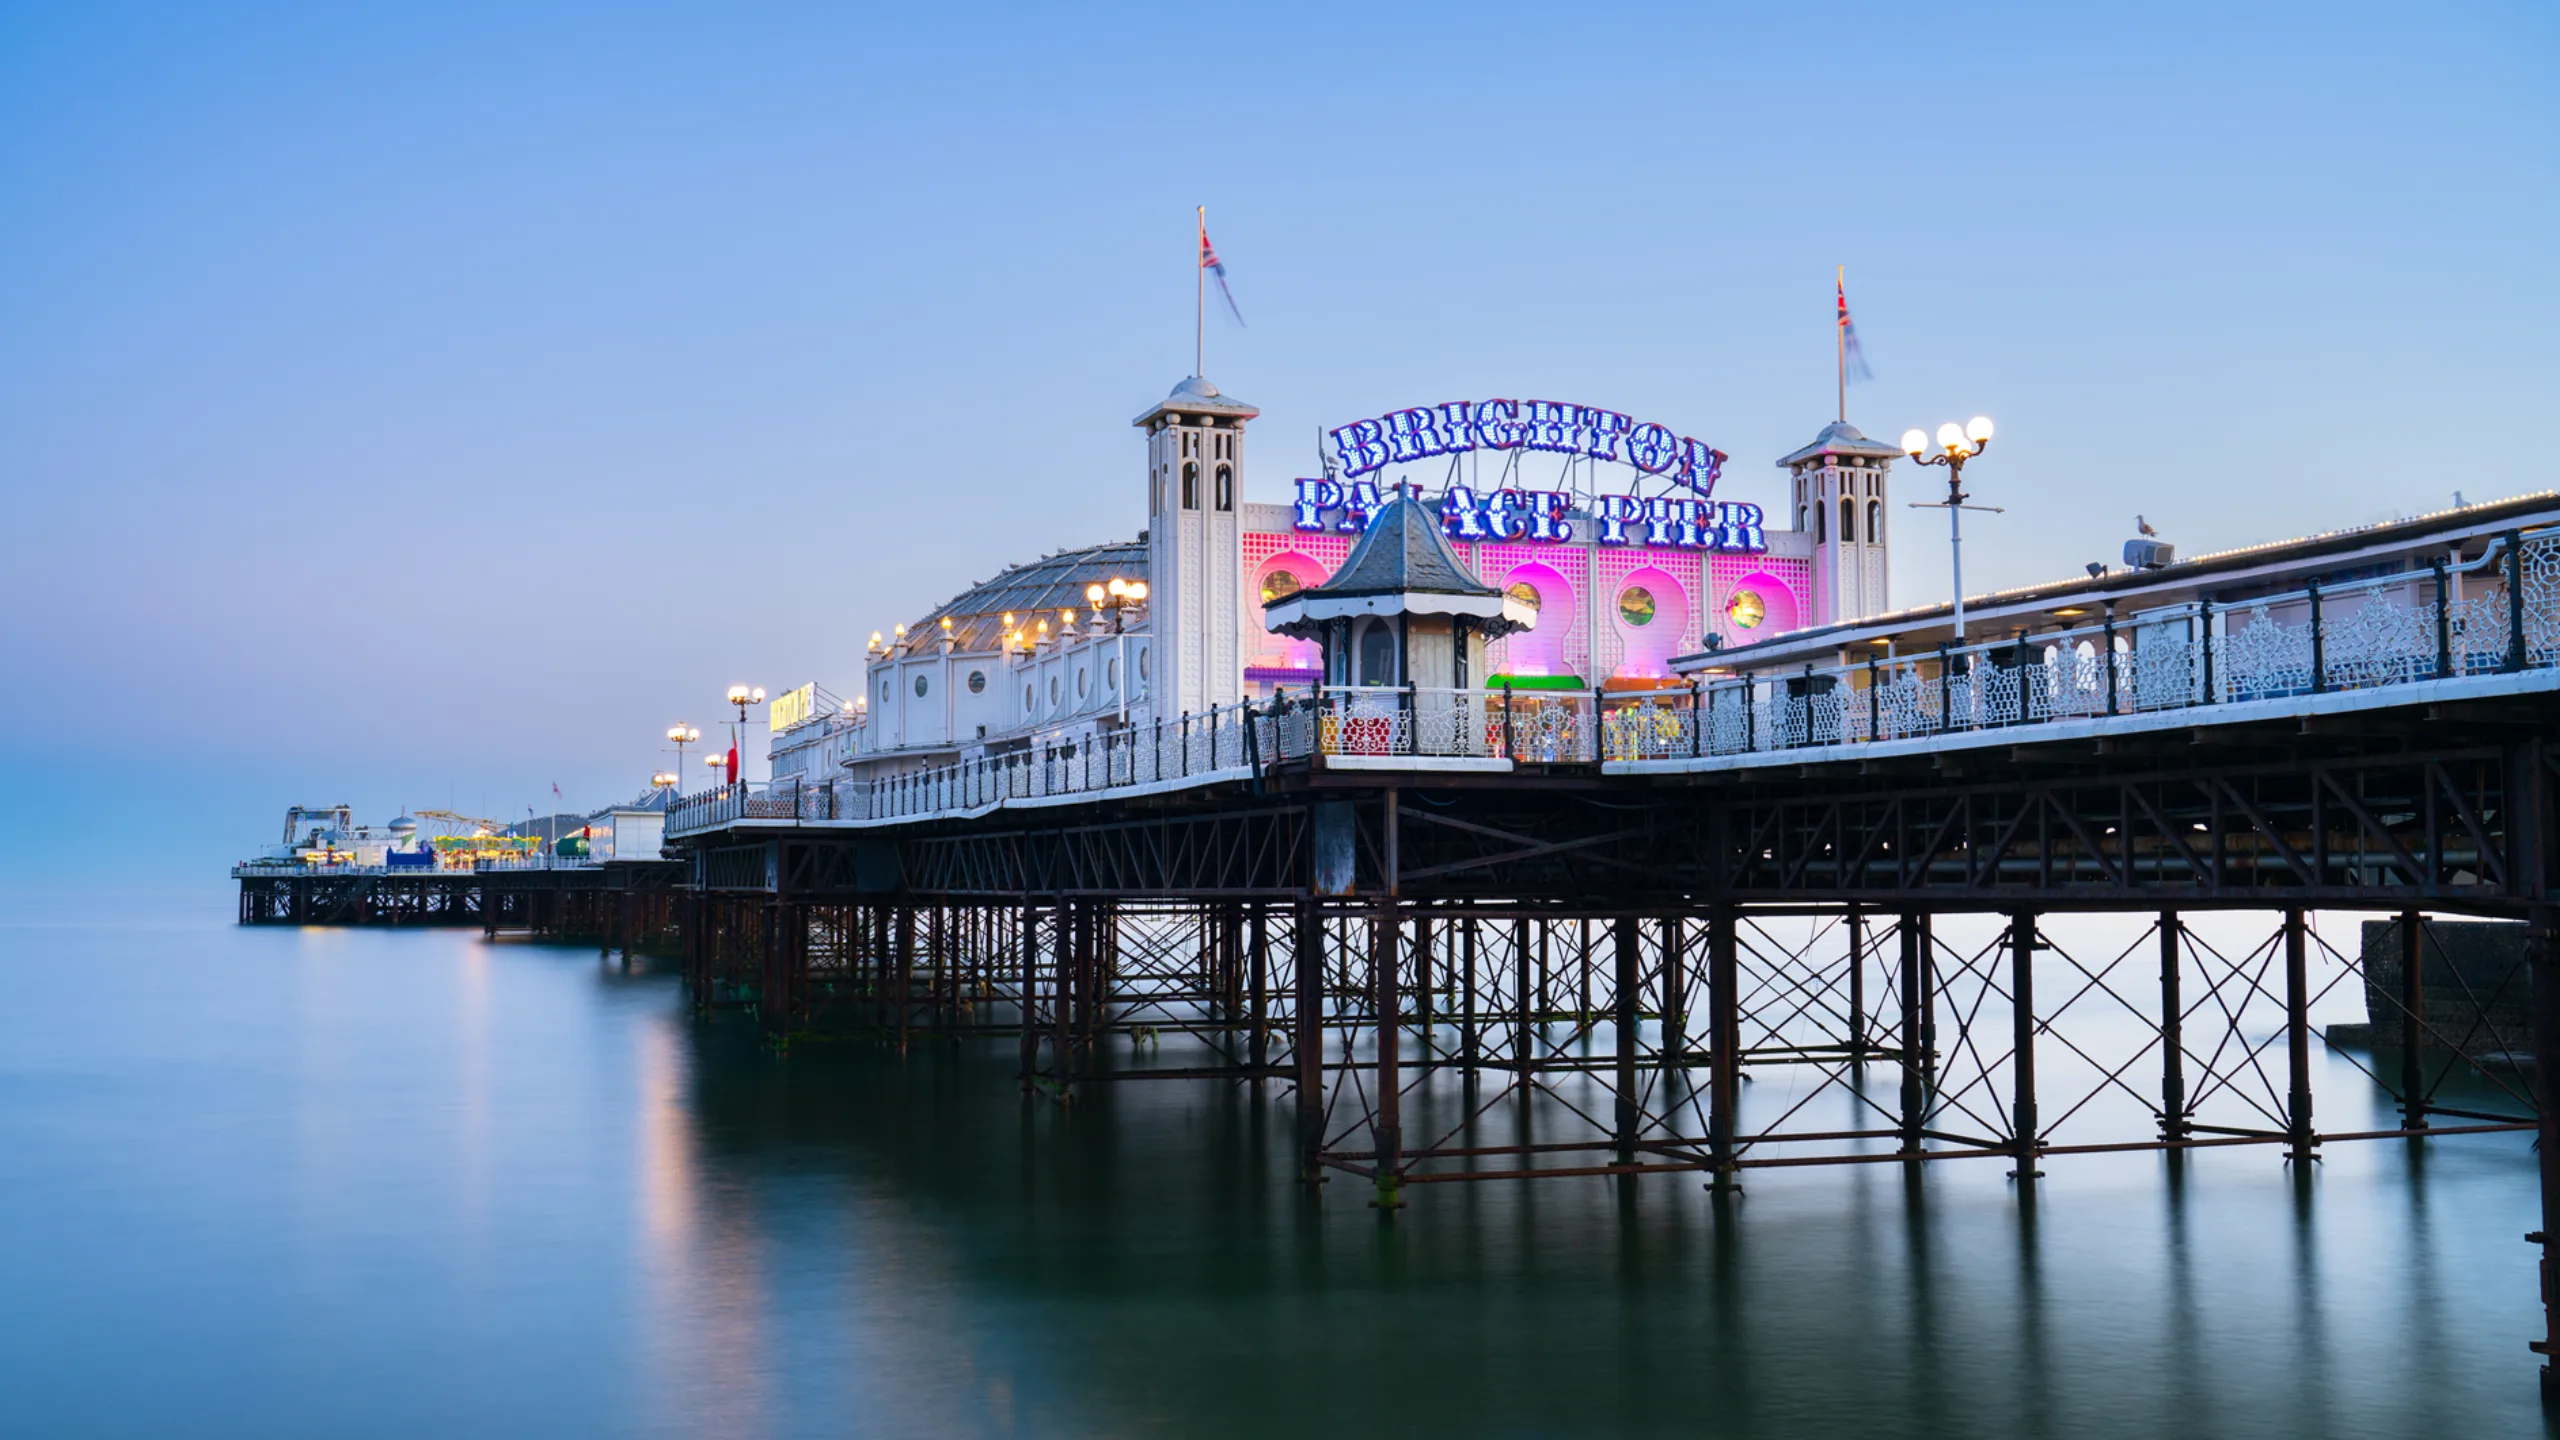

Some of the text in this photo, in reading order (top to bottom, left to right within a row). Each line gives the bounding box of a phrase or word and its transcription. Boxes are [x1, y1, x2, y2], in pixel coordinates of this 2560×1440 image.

[1330, 398, 1728, 497] BRIGHTON
[1293, 478, 1768, 554] PAACE PIER
